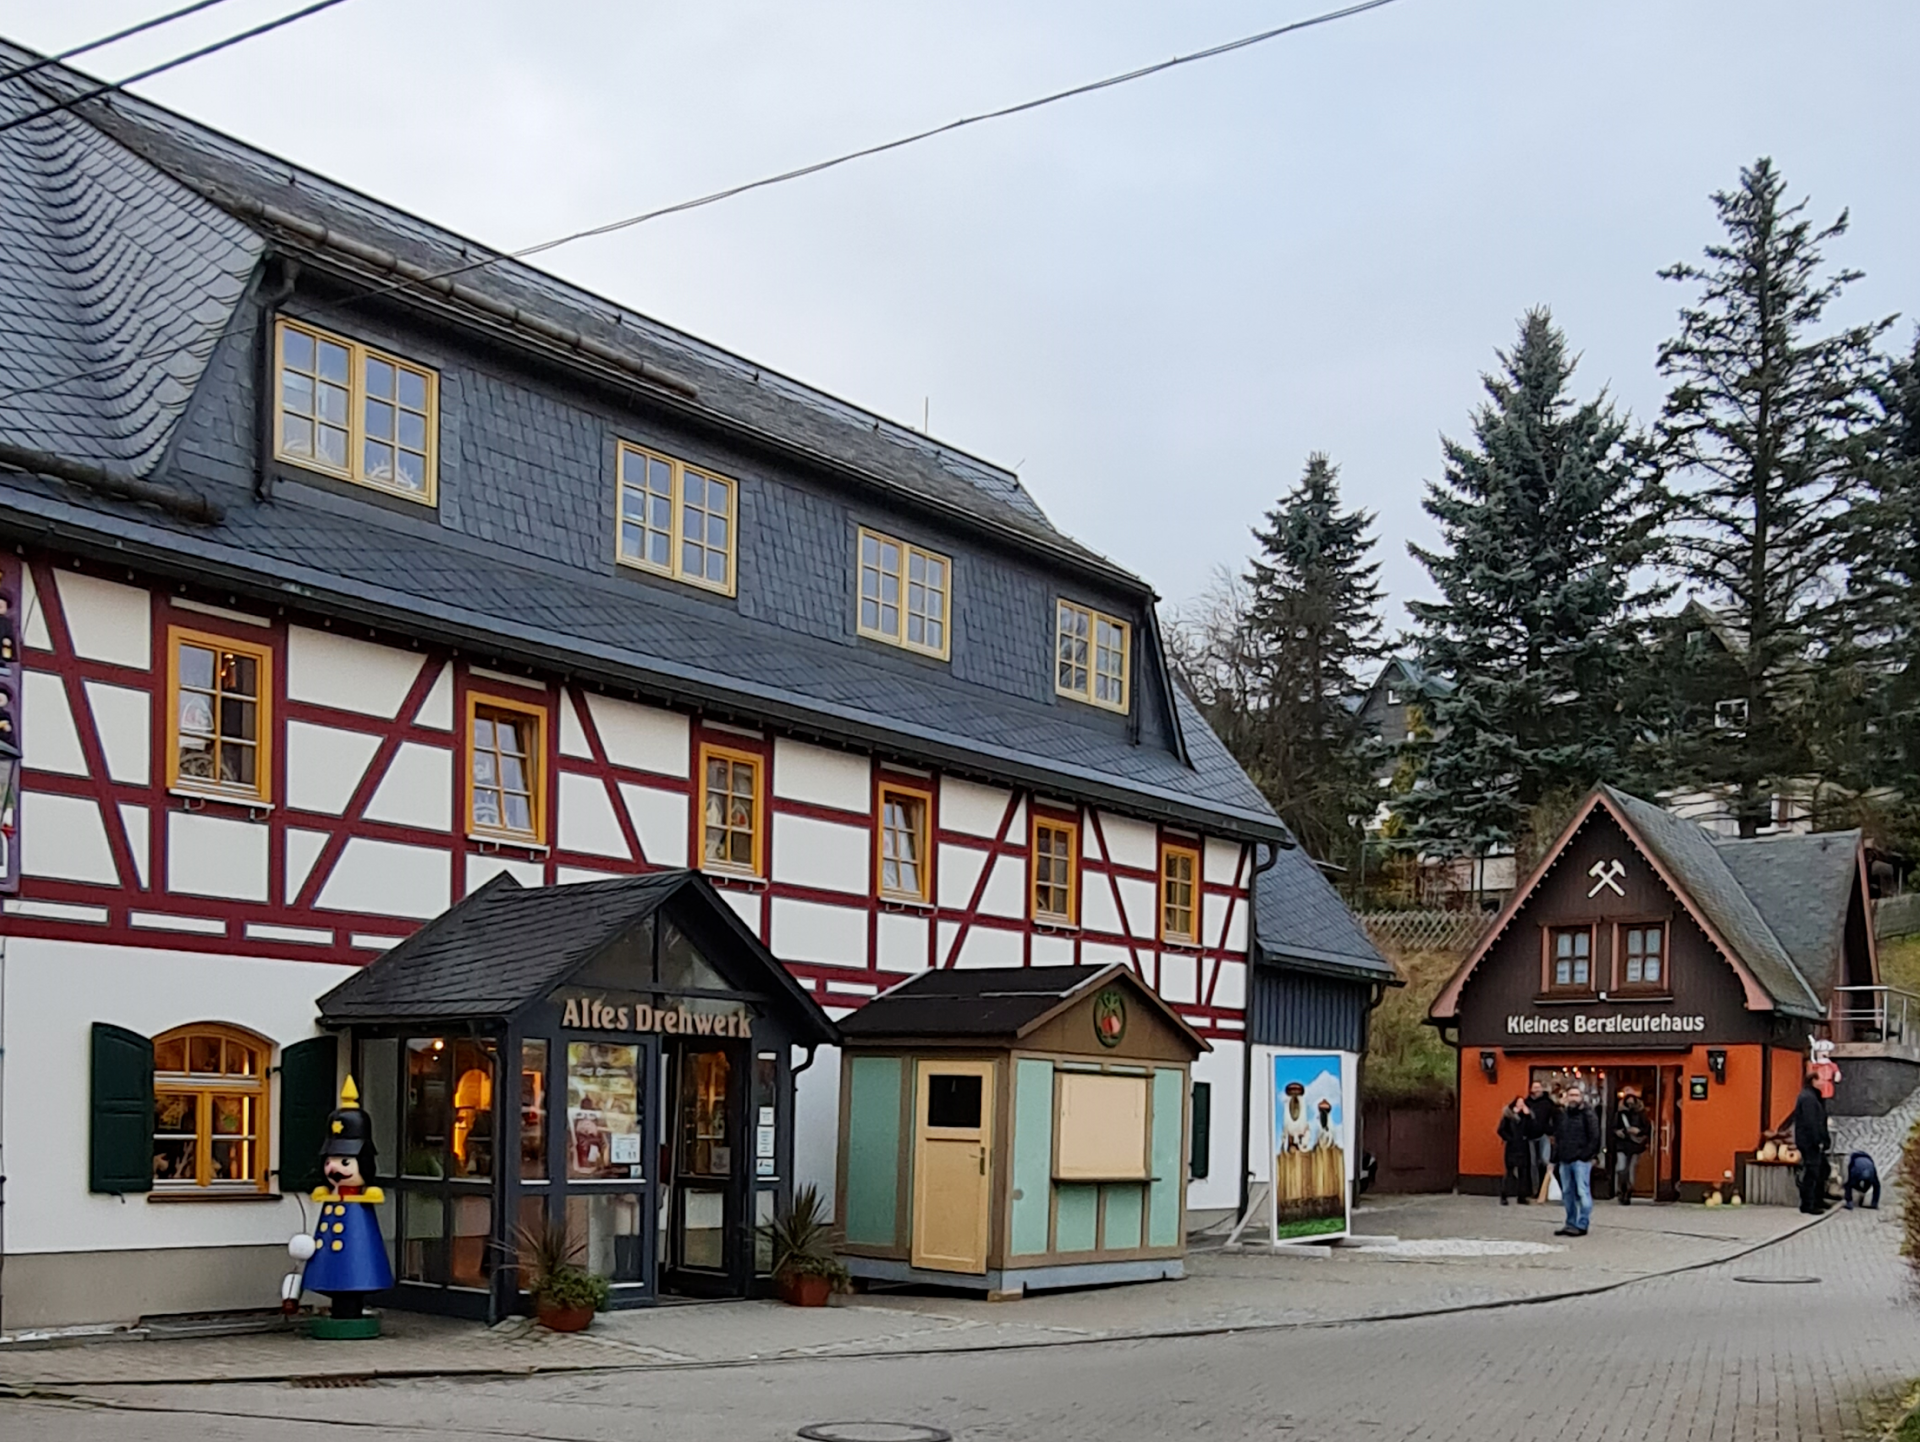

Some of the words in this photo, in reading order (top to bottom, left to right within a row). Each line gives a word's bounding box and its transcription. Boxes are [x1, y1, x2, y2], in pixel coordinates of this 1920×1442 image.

[561, 997, 629, 1030] Altes
[635, 1003, 753, 1039] Drehwerk
[1507, 1015, 1570, 1034] Kleines
[1574, 1013, 1705, 1033] Bergleutehaus
